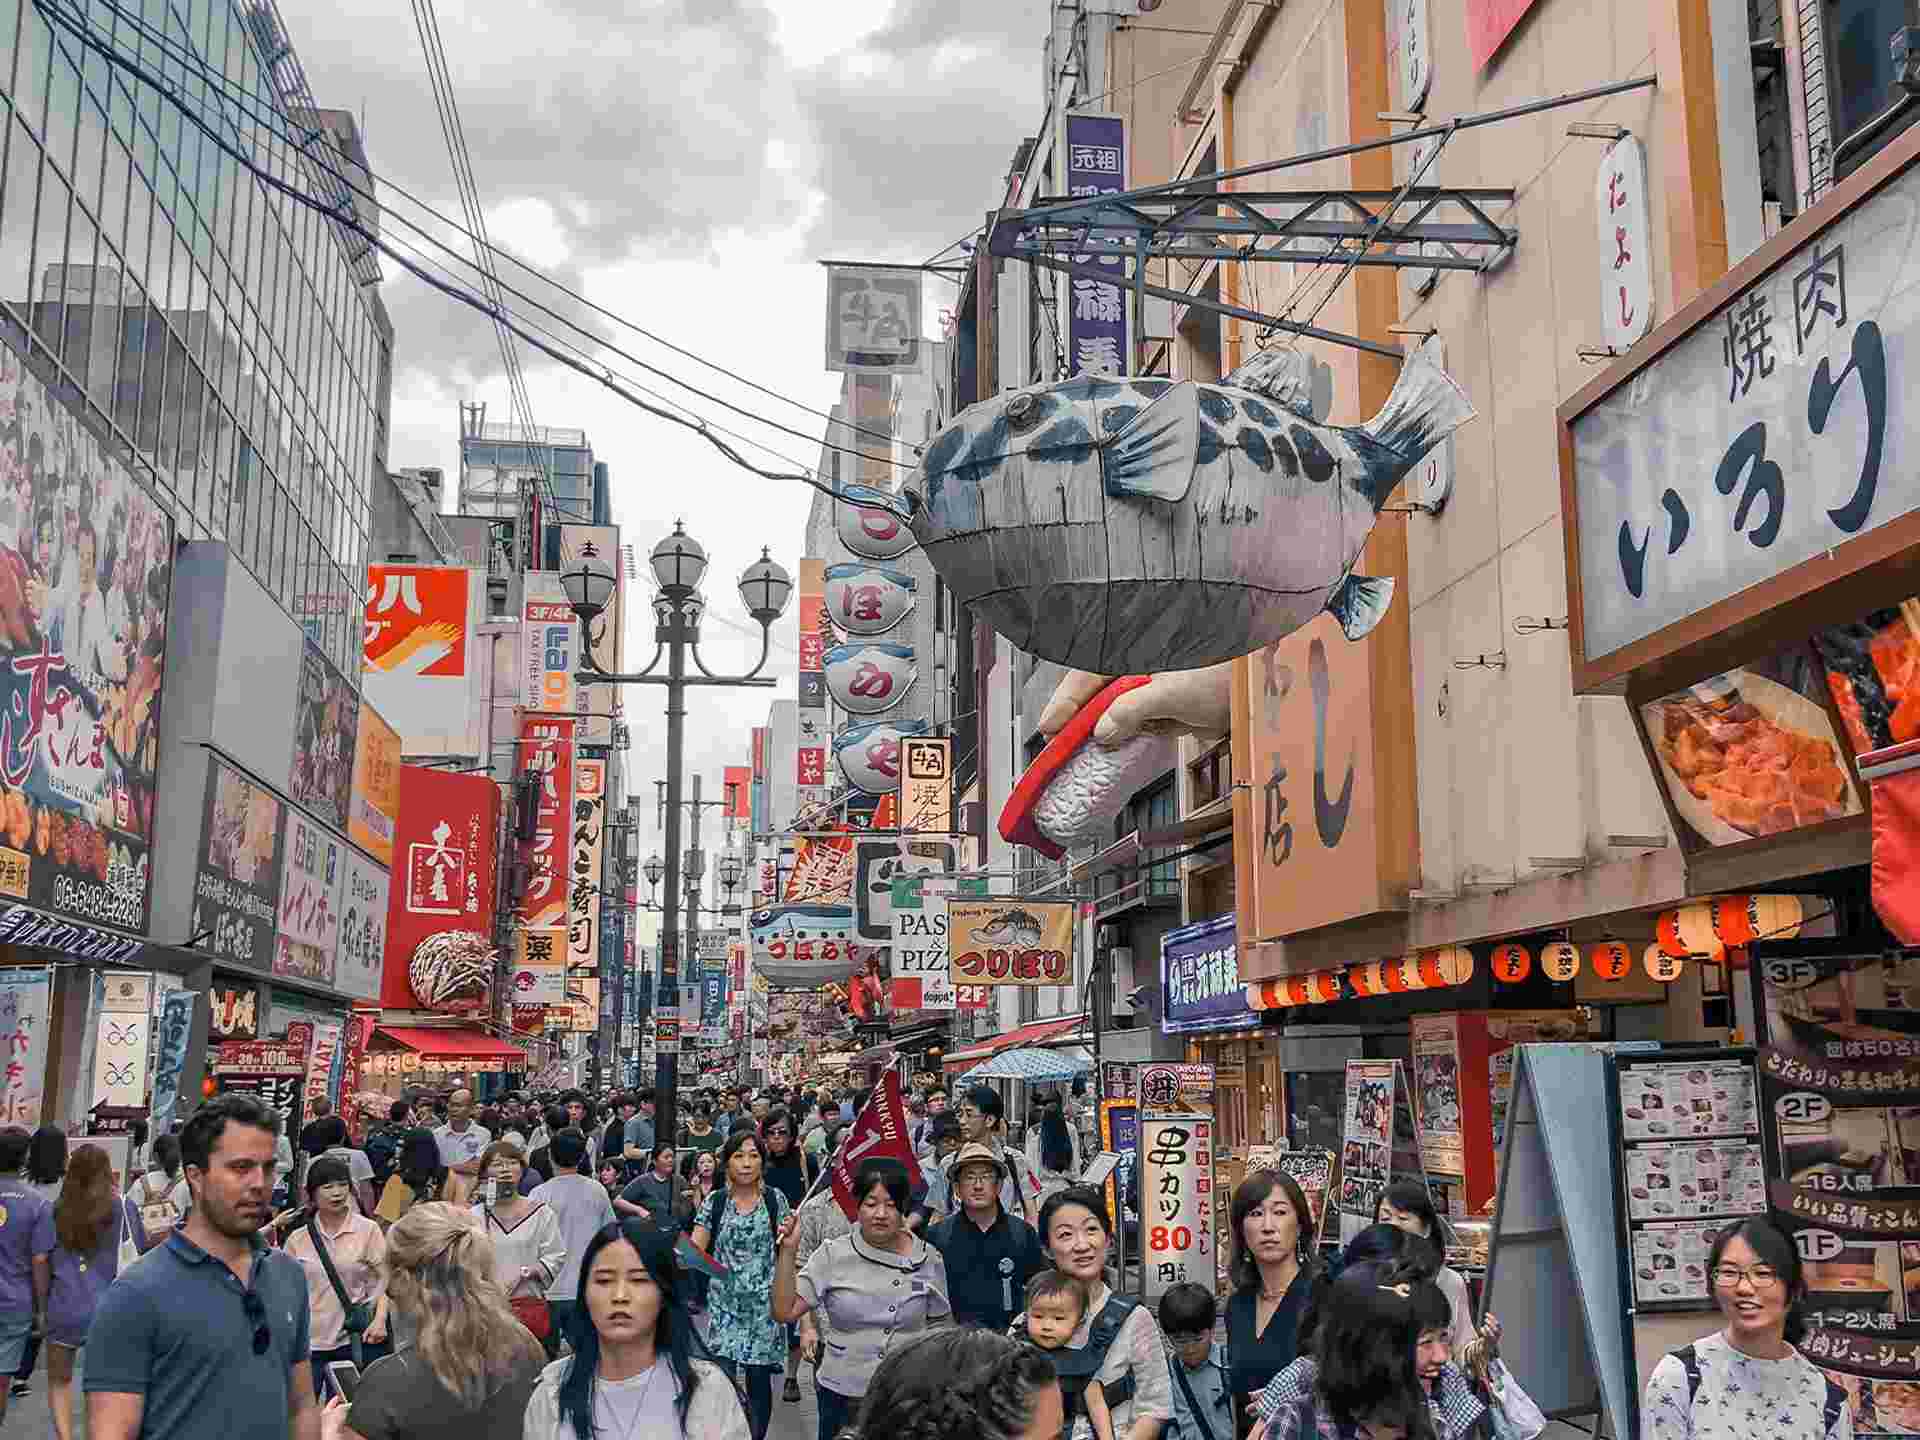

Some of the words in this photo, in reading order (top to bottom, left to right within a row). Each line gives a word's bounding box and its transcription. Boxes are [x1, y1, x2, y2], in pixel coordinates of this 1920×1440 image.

[1723, 241, 1848, 404] 焼肉
[1618, 319, 1888, 599] いろり
[900, 915, 948, 937] PAS
[526, 936, 552, 961] 薬
[902, 951, 949, 971] PIZ
[1773, 964, 1810, 982] 3F
[958, 988, 985, 1004] 2F
[1783, 1099, 1824, 1118] 2F
[1146, 1126, 1191, 1222] 串カツ
[1150, 1226, 1192, 1251] 80
[1800, 1234, 1836, 1249] 1F
[1158, 1263, 1175, 1282] 円
